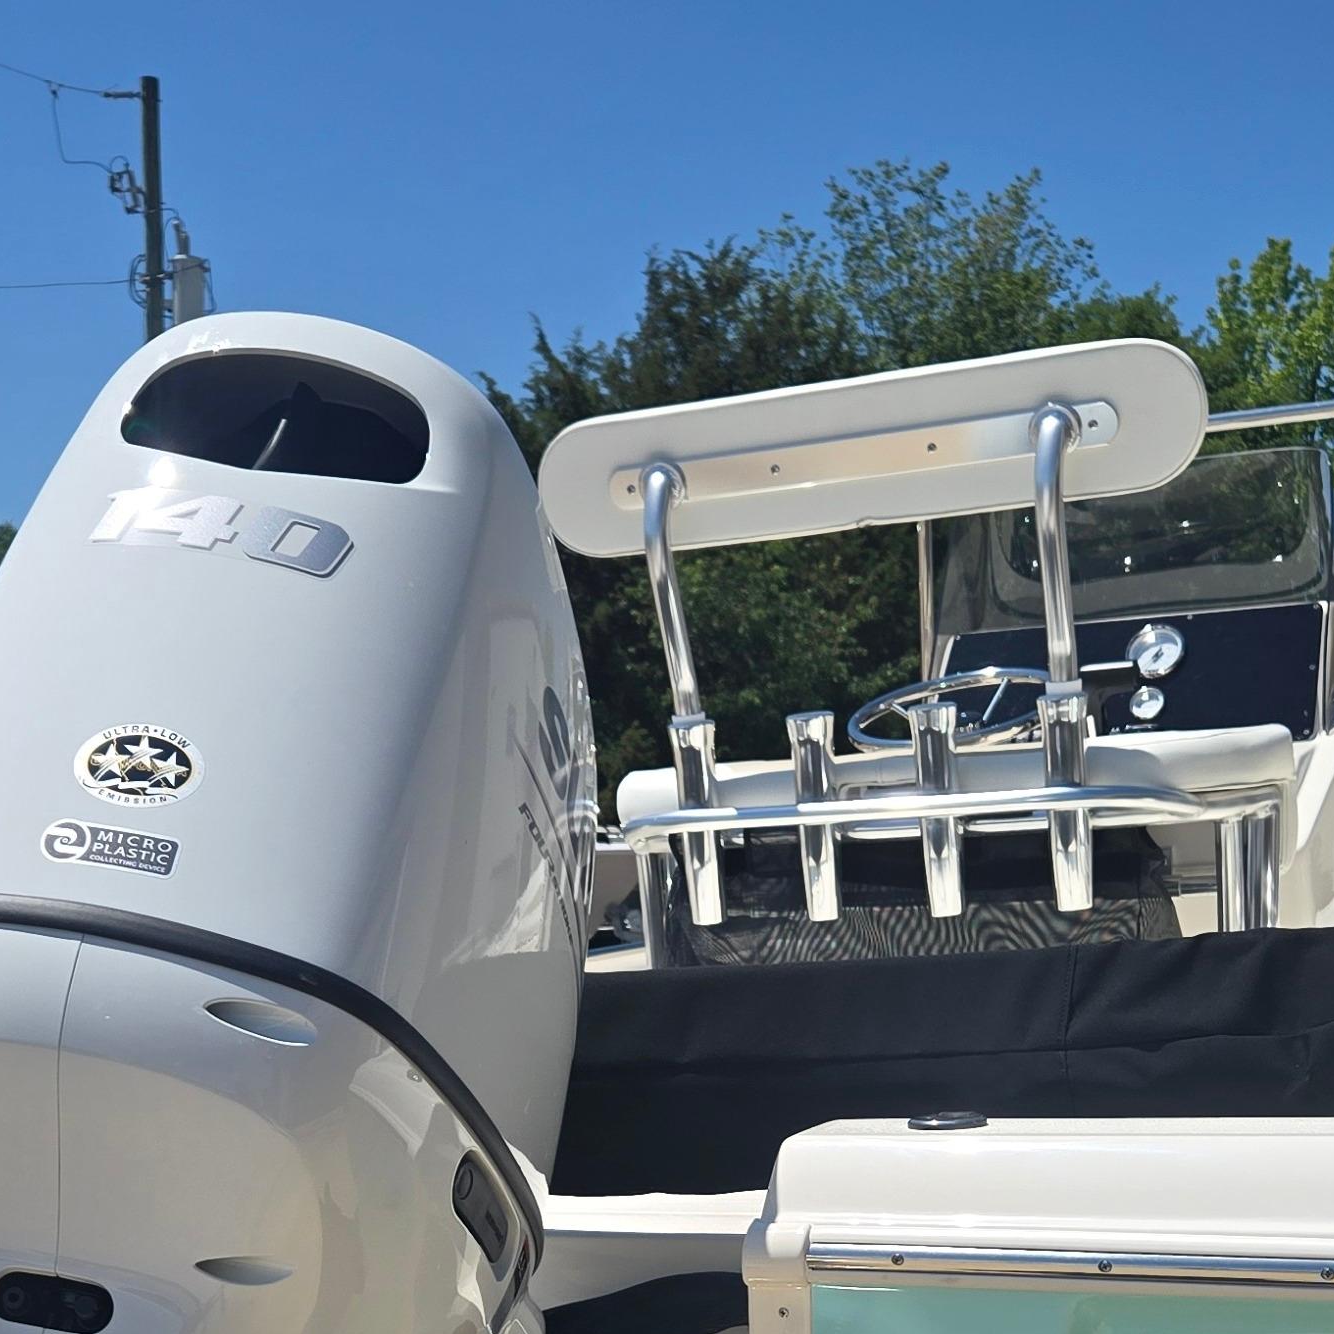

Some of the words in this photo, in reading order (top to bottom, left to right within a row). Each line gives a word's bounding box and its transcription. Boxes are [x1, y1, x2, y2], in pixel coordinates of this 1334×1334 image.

[89, 485, 354, 578] 140
[98, 788, 167, 804] EMISSION
[97, 831, 172, 853] MICRO
[89, 854, 137, 867] COLLECTING
[138, 863, 166, 873] DEVICE
[92, 842, 170, 865] PLASTIC
